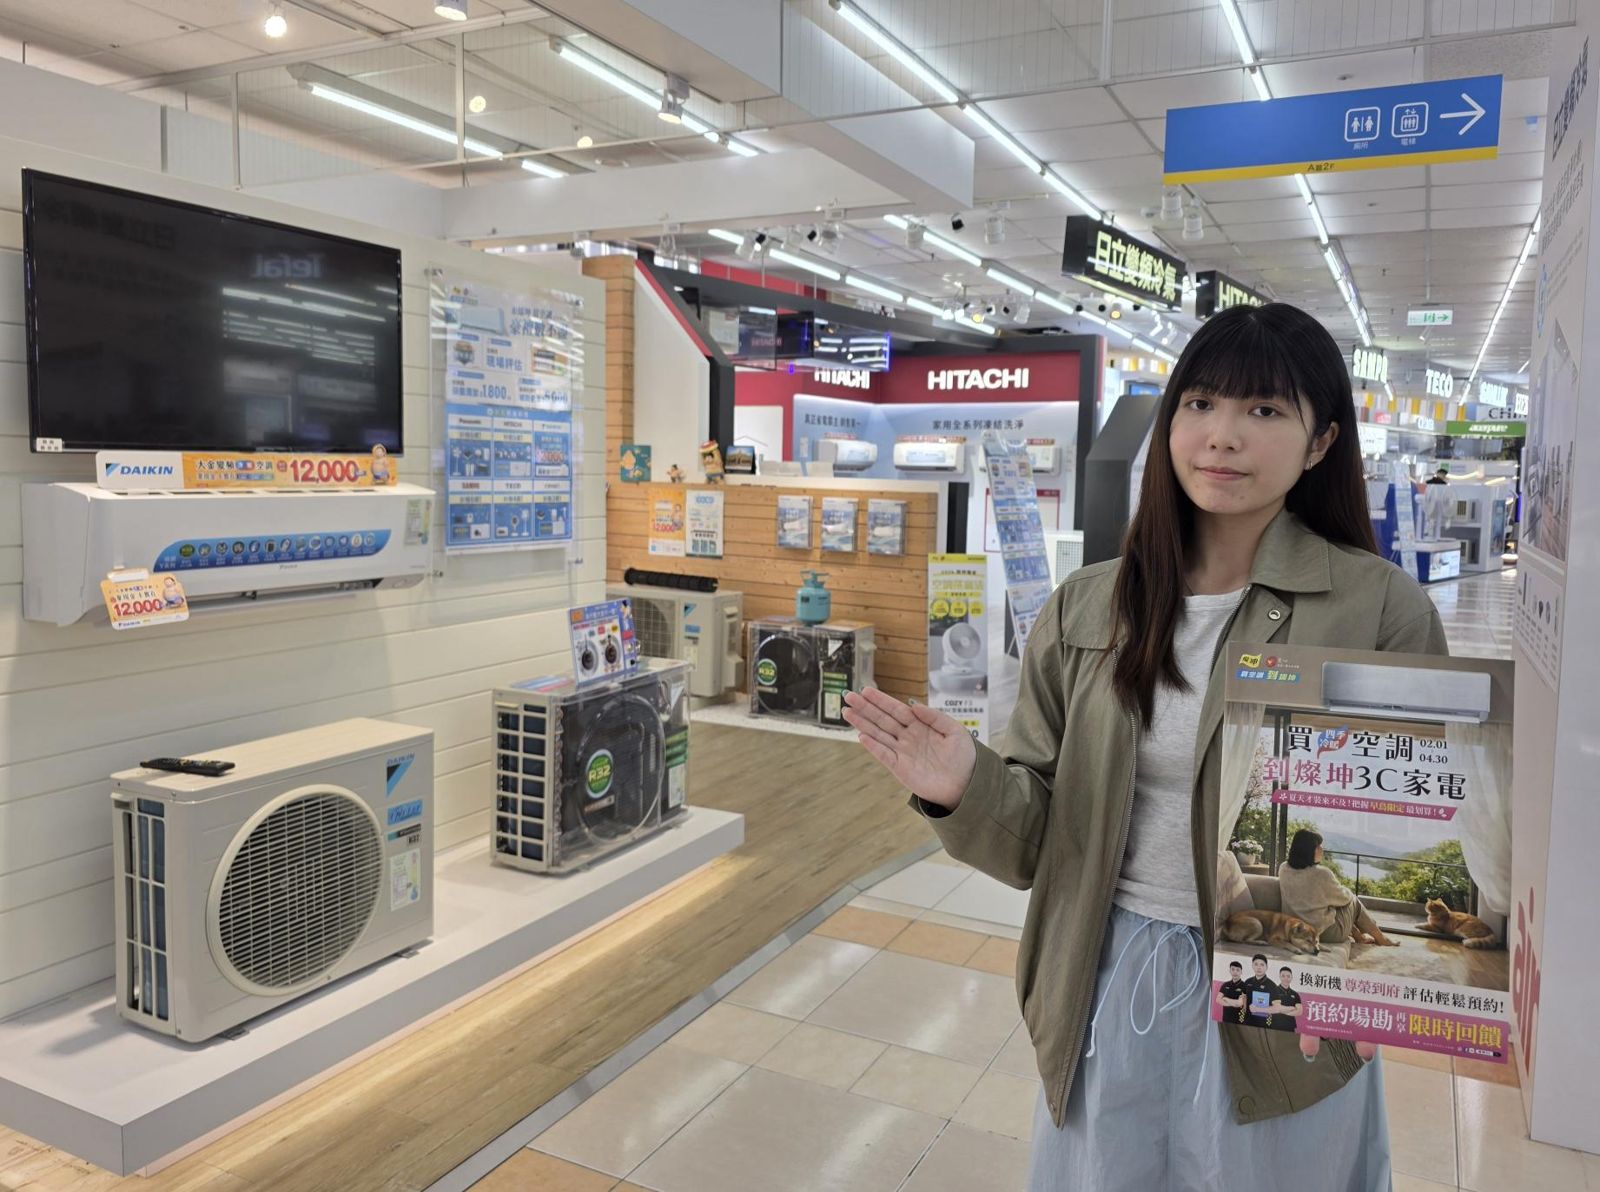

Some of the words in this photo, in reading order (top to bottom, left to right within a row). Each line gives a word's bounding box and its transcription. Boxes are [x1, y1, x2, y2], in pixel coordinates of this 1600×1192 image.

[813, 367, 870, 389] HITACHI
[927, 368, 1029, 391] HITACHI
[1426, 368, 1453, 398] TECO
[121, 466, 173, 475] DAIKIN
[290, 459, 359, 483] 12,000
[114, 599, 163, 616] 12,000
[1288, 726, 1313, 752] 買
[1352, 731, 1413, 763] 空調
[1420, 738, 1448, 750] 02.01
[1420, 753, 1448, 764] 04.30
[588, 764, 611, 782] R32
[1300, 971, 1342, 991] 換新機
[1344, 978, 1400, 998] 尊榮到府
[1307, 1000, 1392, 1031] 預約場勘
[1409, 1014, 1501, 1048] 限時回饋
